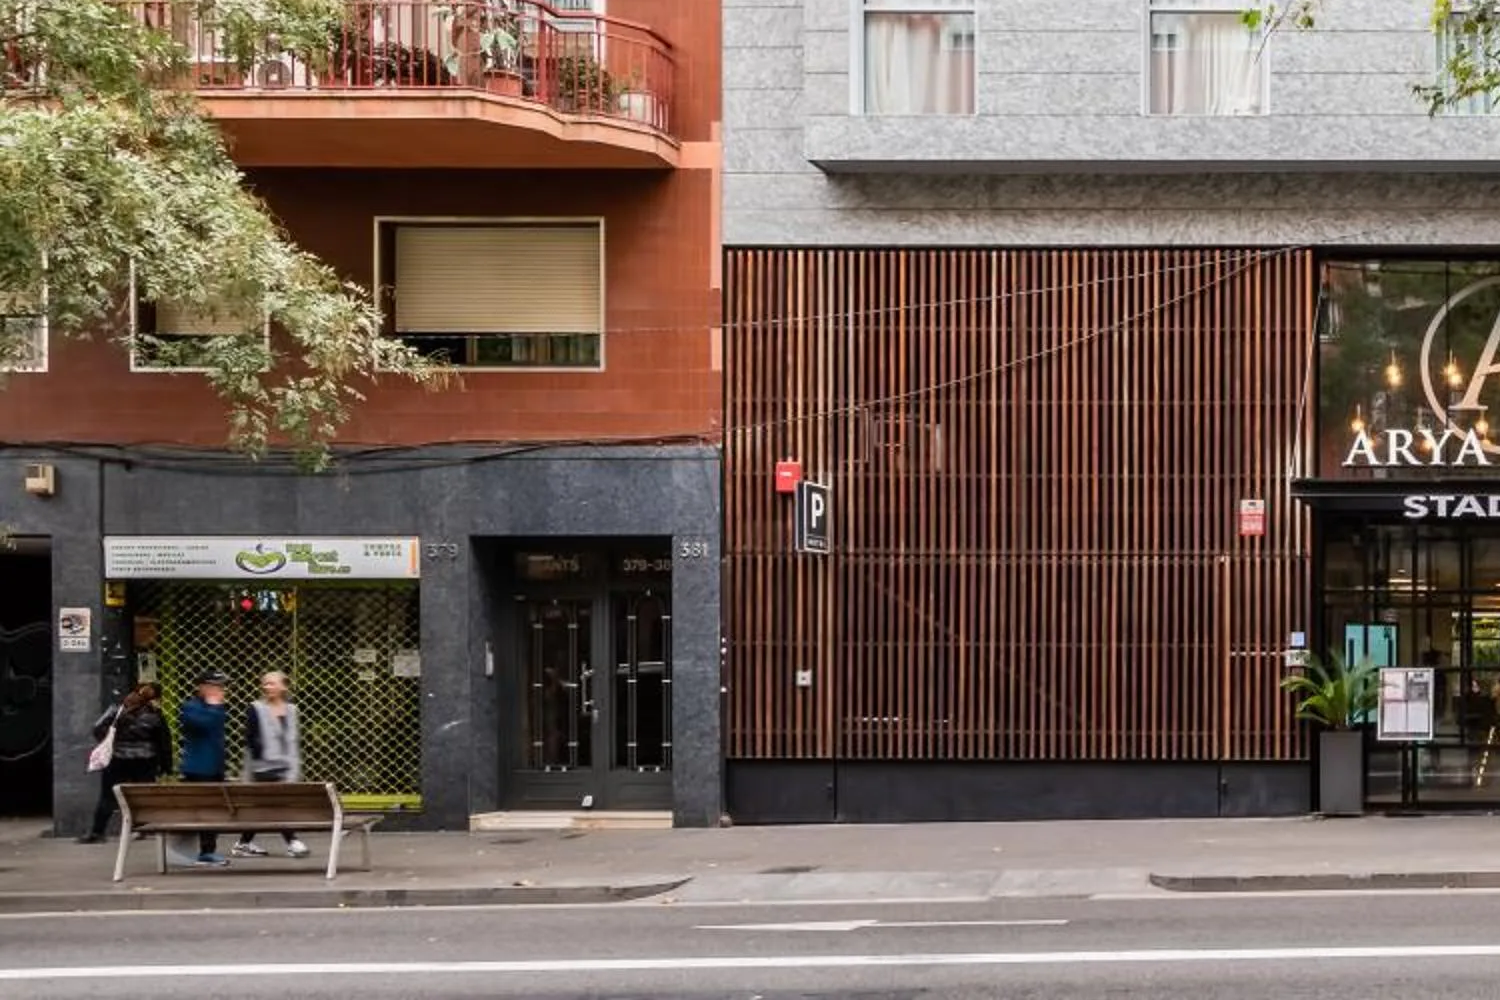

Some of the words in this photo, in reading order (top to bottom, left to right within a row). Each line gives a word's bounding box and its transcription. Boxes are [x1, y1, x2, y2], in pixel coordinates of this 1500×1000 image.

[1342, 427, 1492, 467] ARYA
[811, 492, 824, 528] P
[623, 558, 673, 572] 379-38
